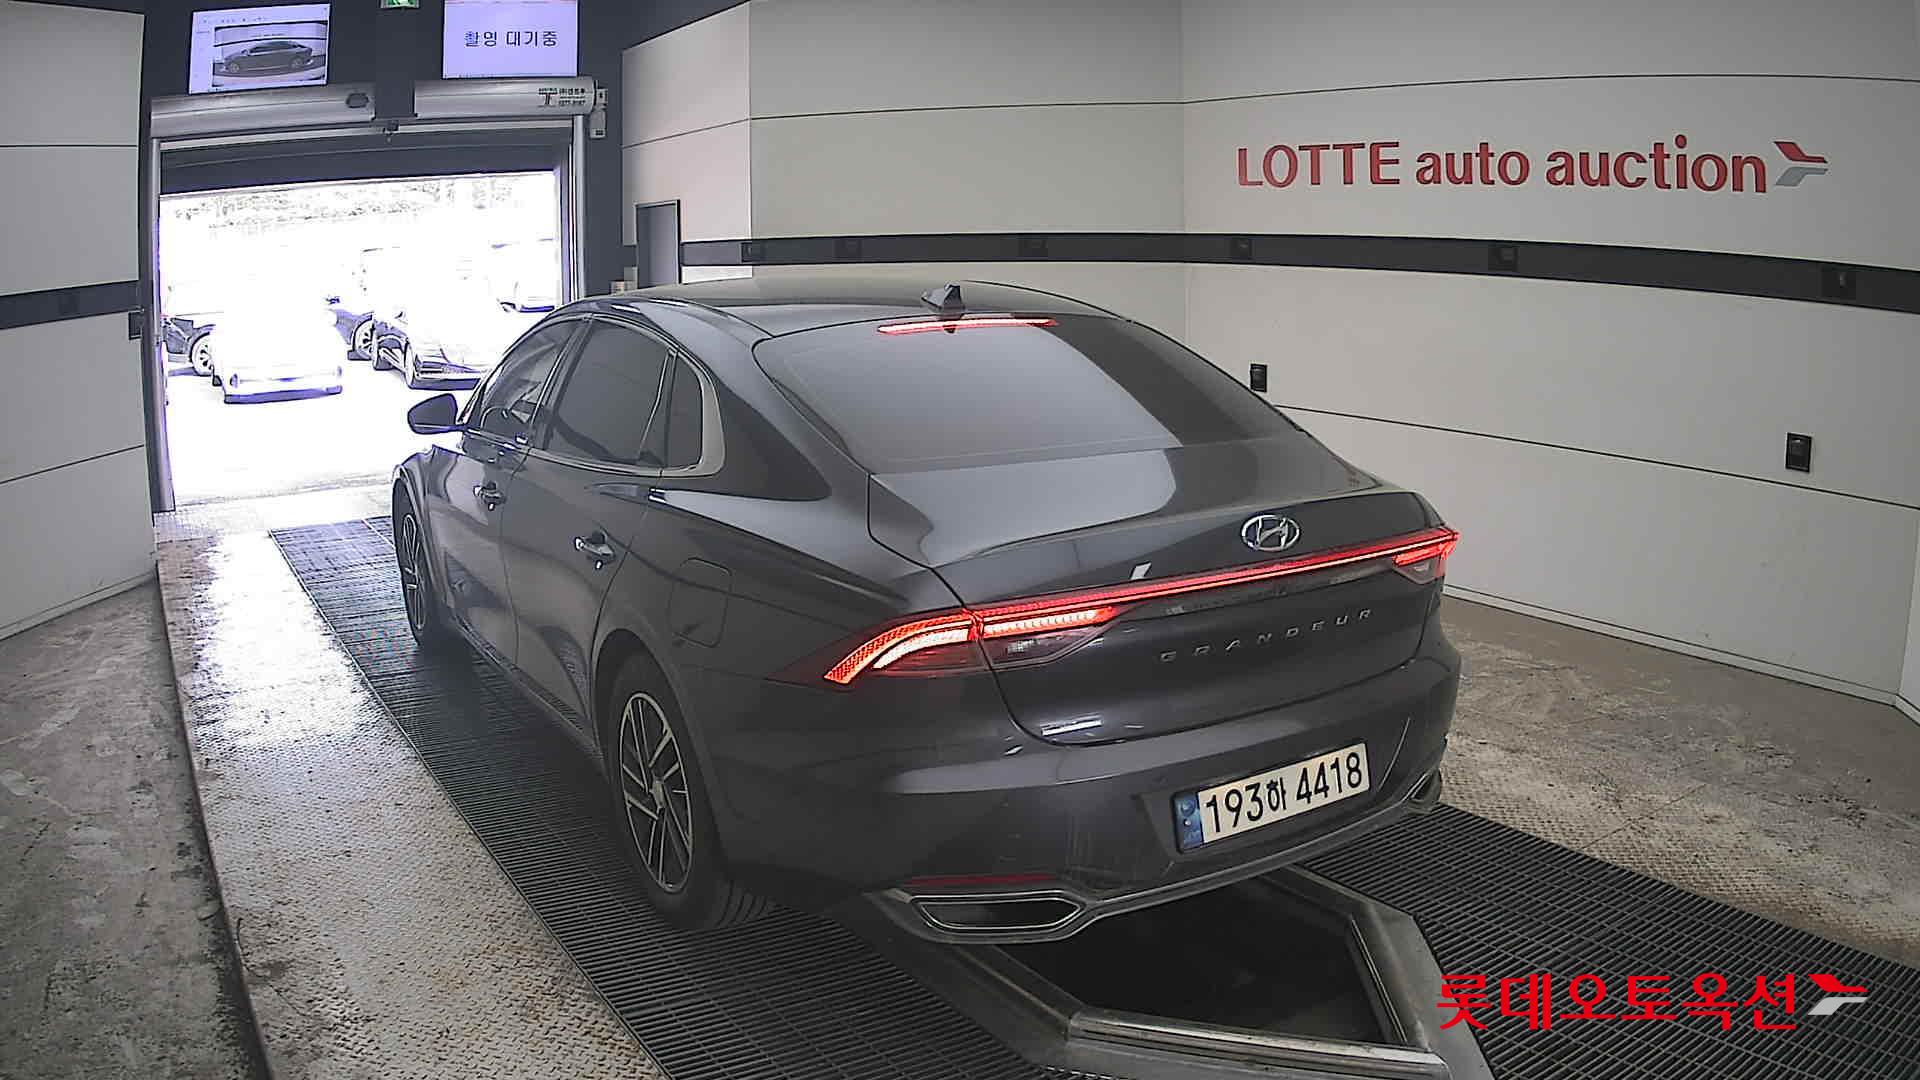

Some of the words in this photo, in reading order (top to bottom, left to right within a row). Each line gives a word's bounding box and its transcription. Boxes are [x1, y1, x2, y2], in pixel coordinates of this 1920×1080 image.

[506, 31, 557, 47] 대기중
[1237, 142, 1400, 188] LOTTE
[1415, 142, 1530, 186] auto
[1546, 134, 1767, 193] auction
[1160, 608, 1371, 662] GRANDEUR
[1295, 752, 1362, 805] 4418
